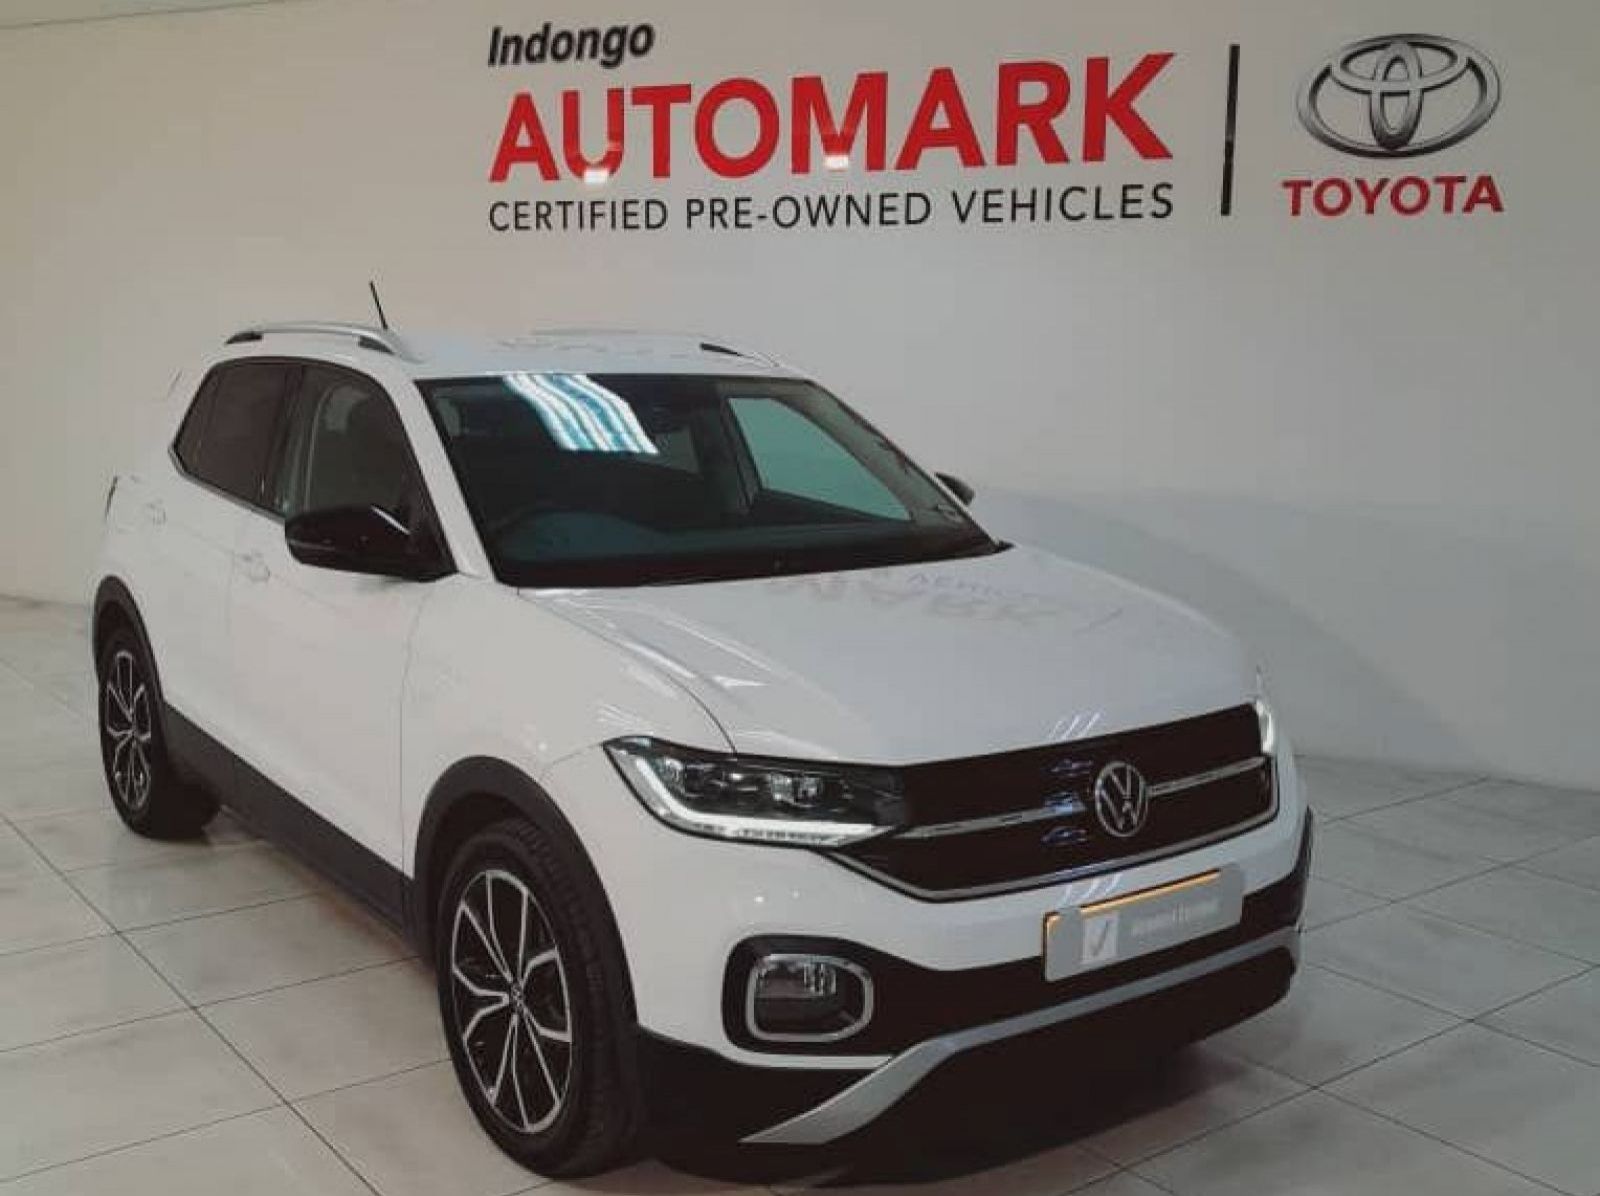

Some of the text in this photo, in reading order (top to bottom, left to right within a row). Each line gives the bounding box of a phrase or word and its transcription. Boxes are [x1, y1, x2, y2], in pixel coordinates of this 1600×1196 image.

[488, 23, 655, 67] Indongo
[489, 52, 1175, 183] AUTOMARK
[488, 182, 1174, 232] CERTIFIED PRE-OWNED VEHICLES
[1282, 175, 1504, 216] TOYOTA
